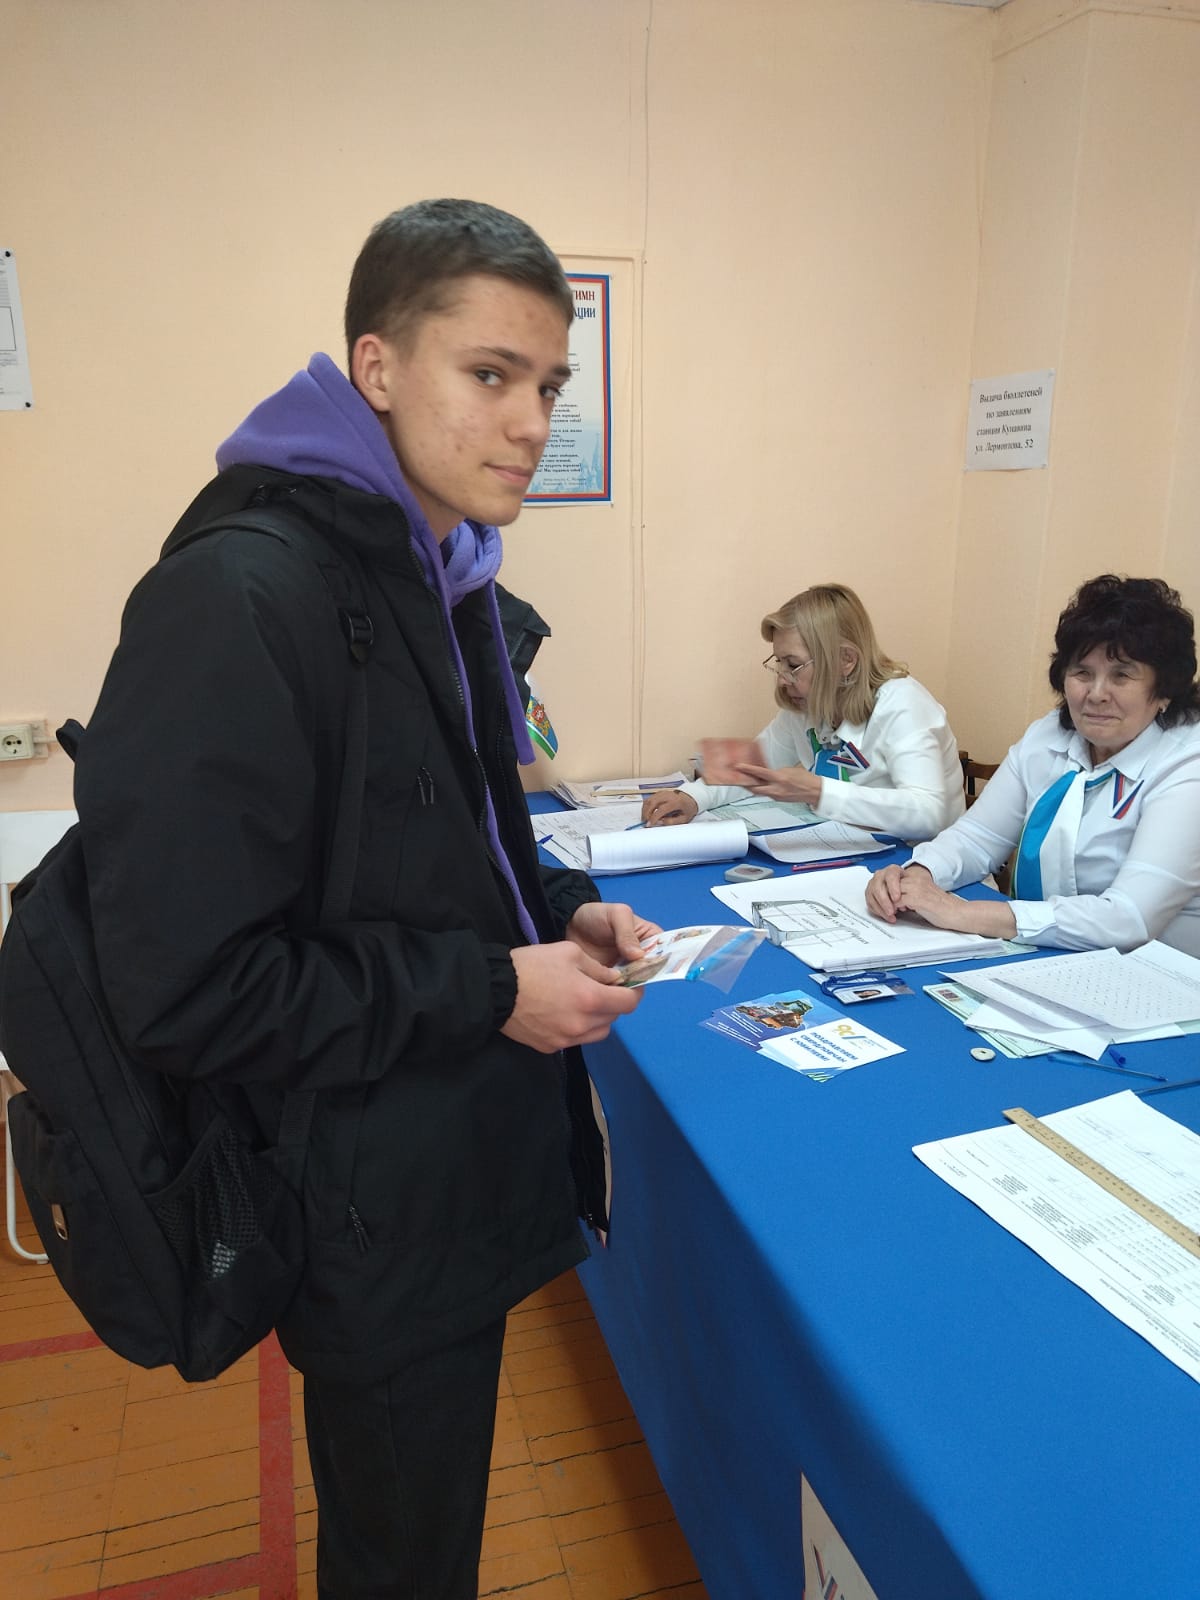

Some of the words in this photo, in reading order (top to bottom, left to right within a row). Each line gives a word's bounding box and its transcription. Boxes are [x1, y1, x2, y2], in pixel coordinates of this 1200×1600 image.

[979, 393, 1003, 404] Выдача
[1003, 386, 1043, 401] бюллетеней
[986, 411, 995, 419] по
[996, 408, 1032, 418] заявлениям
[1024, 438, 1034, 448] 52
